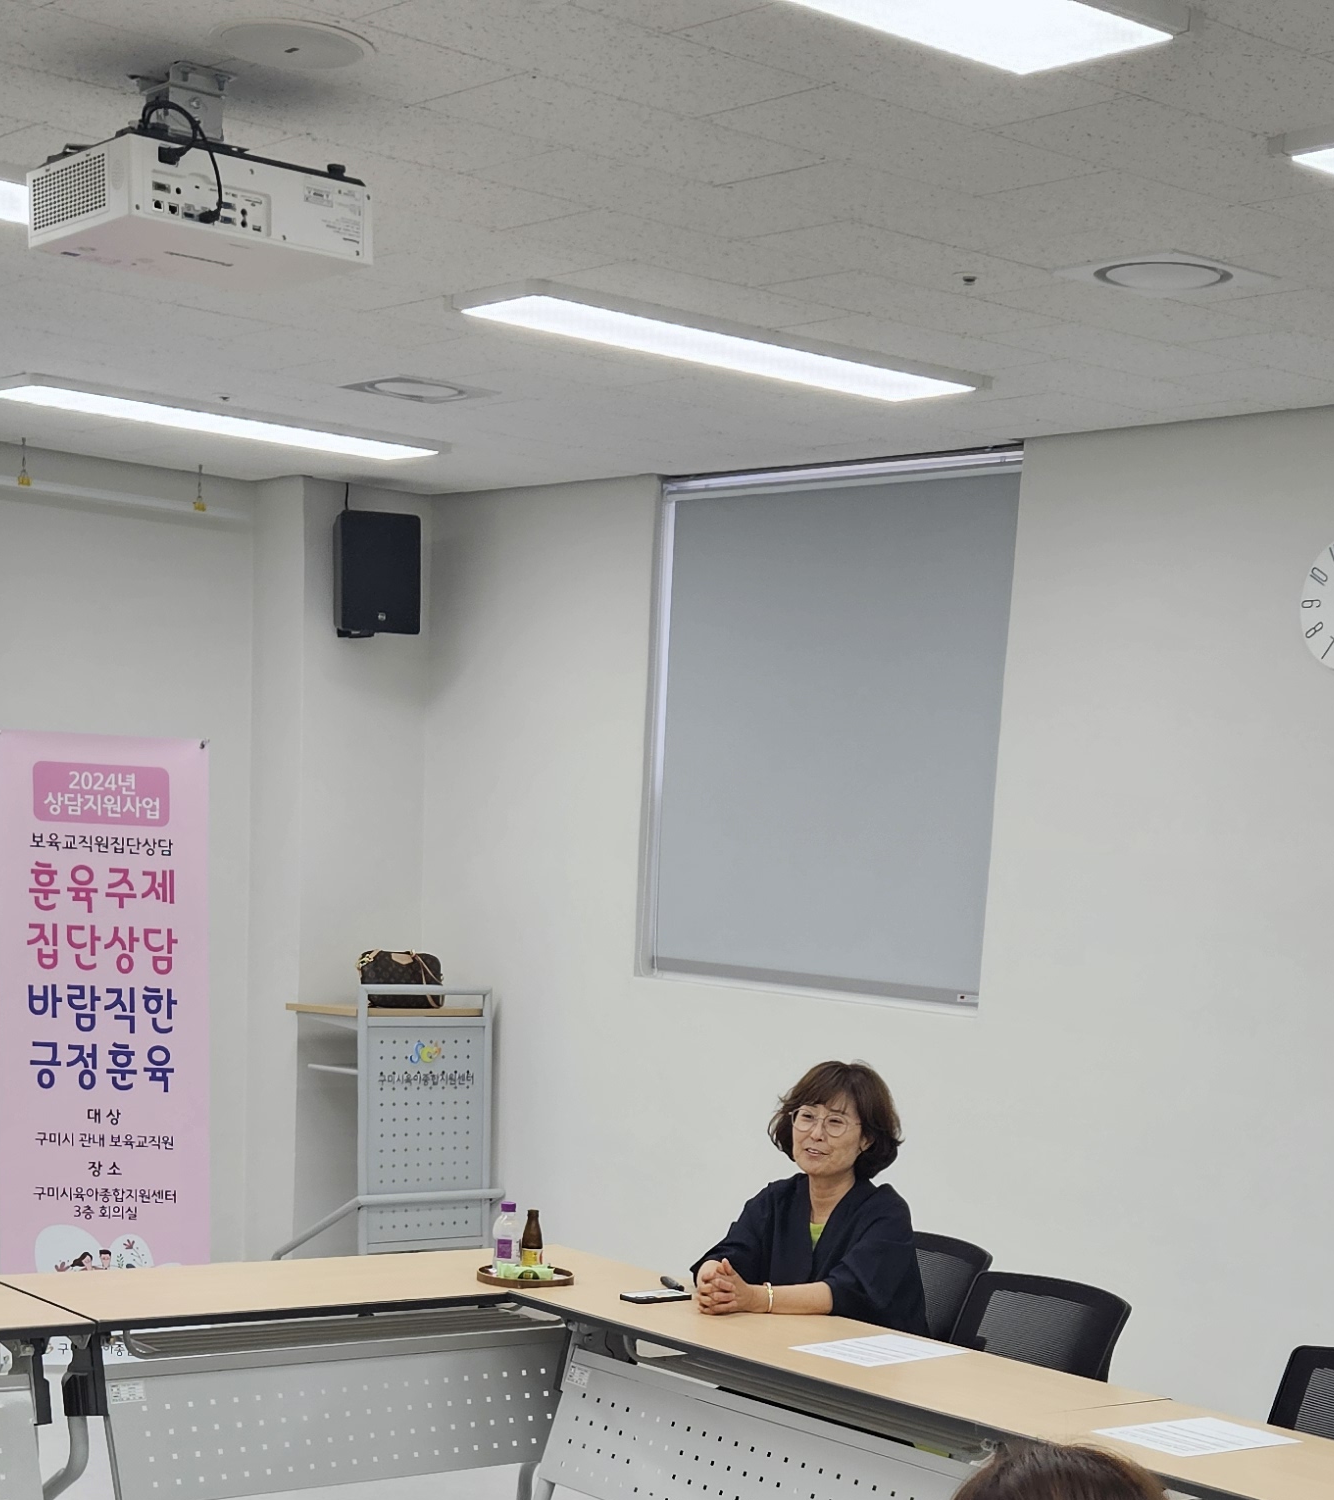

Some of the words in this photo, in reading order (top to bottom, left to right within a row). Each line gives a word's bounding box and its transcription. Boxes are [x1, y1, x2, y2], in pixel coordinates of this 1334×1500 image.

[1309, 567, 1328, 586] 10
[1305, 621, 1323, 639] 8
[1320, 636, 1334, 660] 7
[68, 771, 136, 795] 2024년
[43, 792, 160, 819] 상담지원사업
[29, 832, 174, 857] 보육교직원집단상담
[28, 860, 175, 914] 훈육주제
[26, 922, 178, 975] 집단상담
[27, 983, 178, 1035] 바람직한
[29, 1040, 175, 1093] 긍정훈육
[35, 1131, 74, 1146] 구미시
[78, 1132, 105, 1148] 관내
[109, 1133, 174, 1150] 보육교직원
[33, 1186, 177, 1204] 구미시육아종합지원센터
[73, 1205, 95, 1220] 3층
[98, 1205, 138, 1220] 회의실
